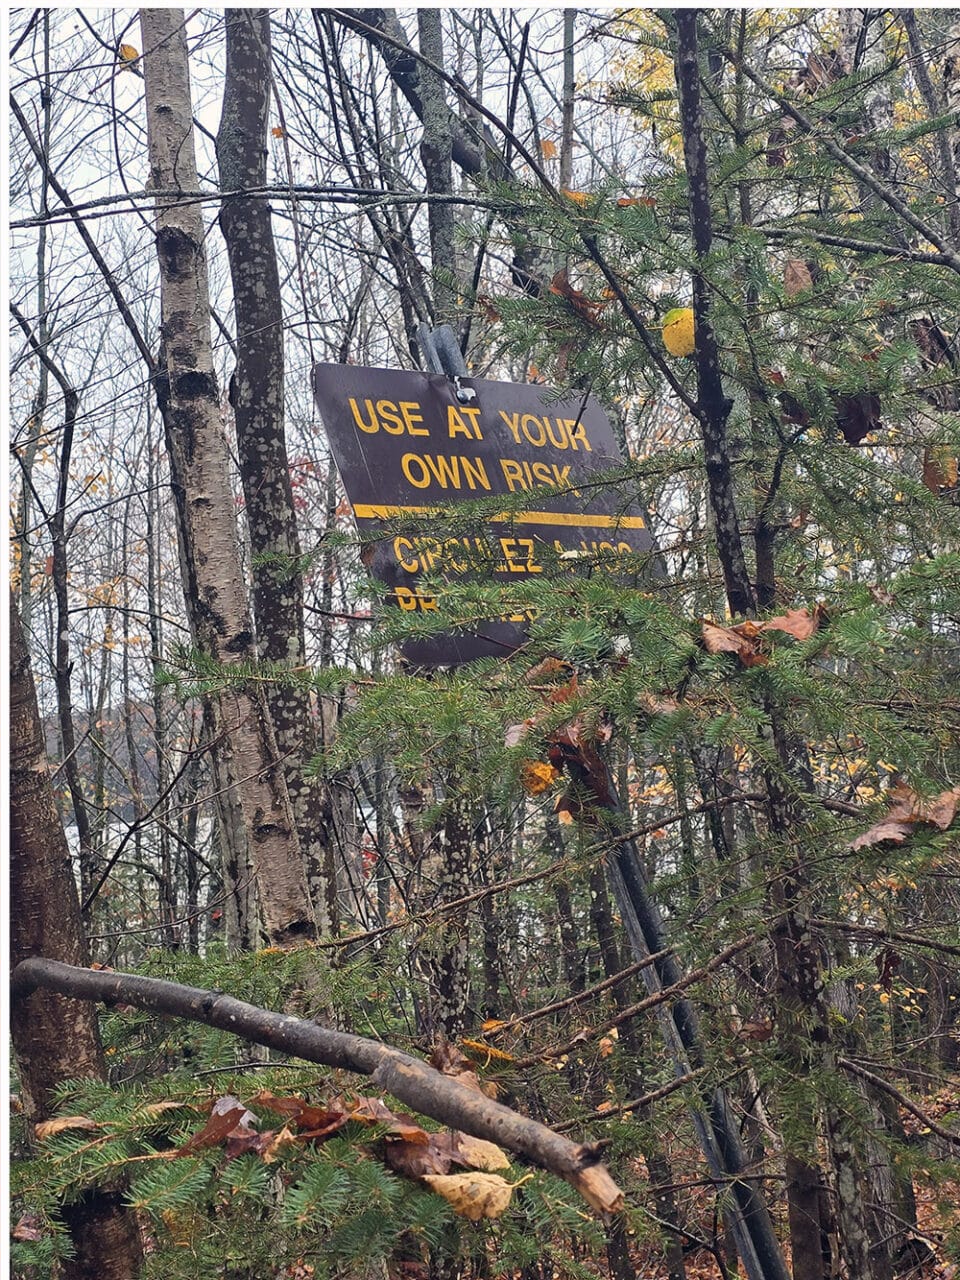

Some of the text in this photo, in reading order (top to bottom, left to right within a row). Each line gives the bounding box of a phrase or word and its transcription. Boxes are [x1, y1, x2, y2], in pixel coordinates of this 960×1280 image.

[348, 398, 592, 452] USE AT YOUR
[401, 452, 582, 498] OWN RISK
